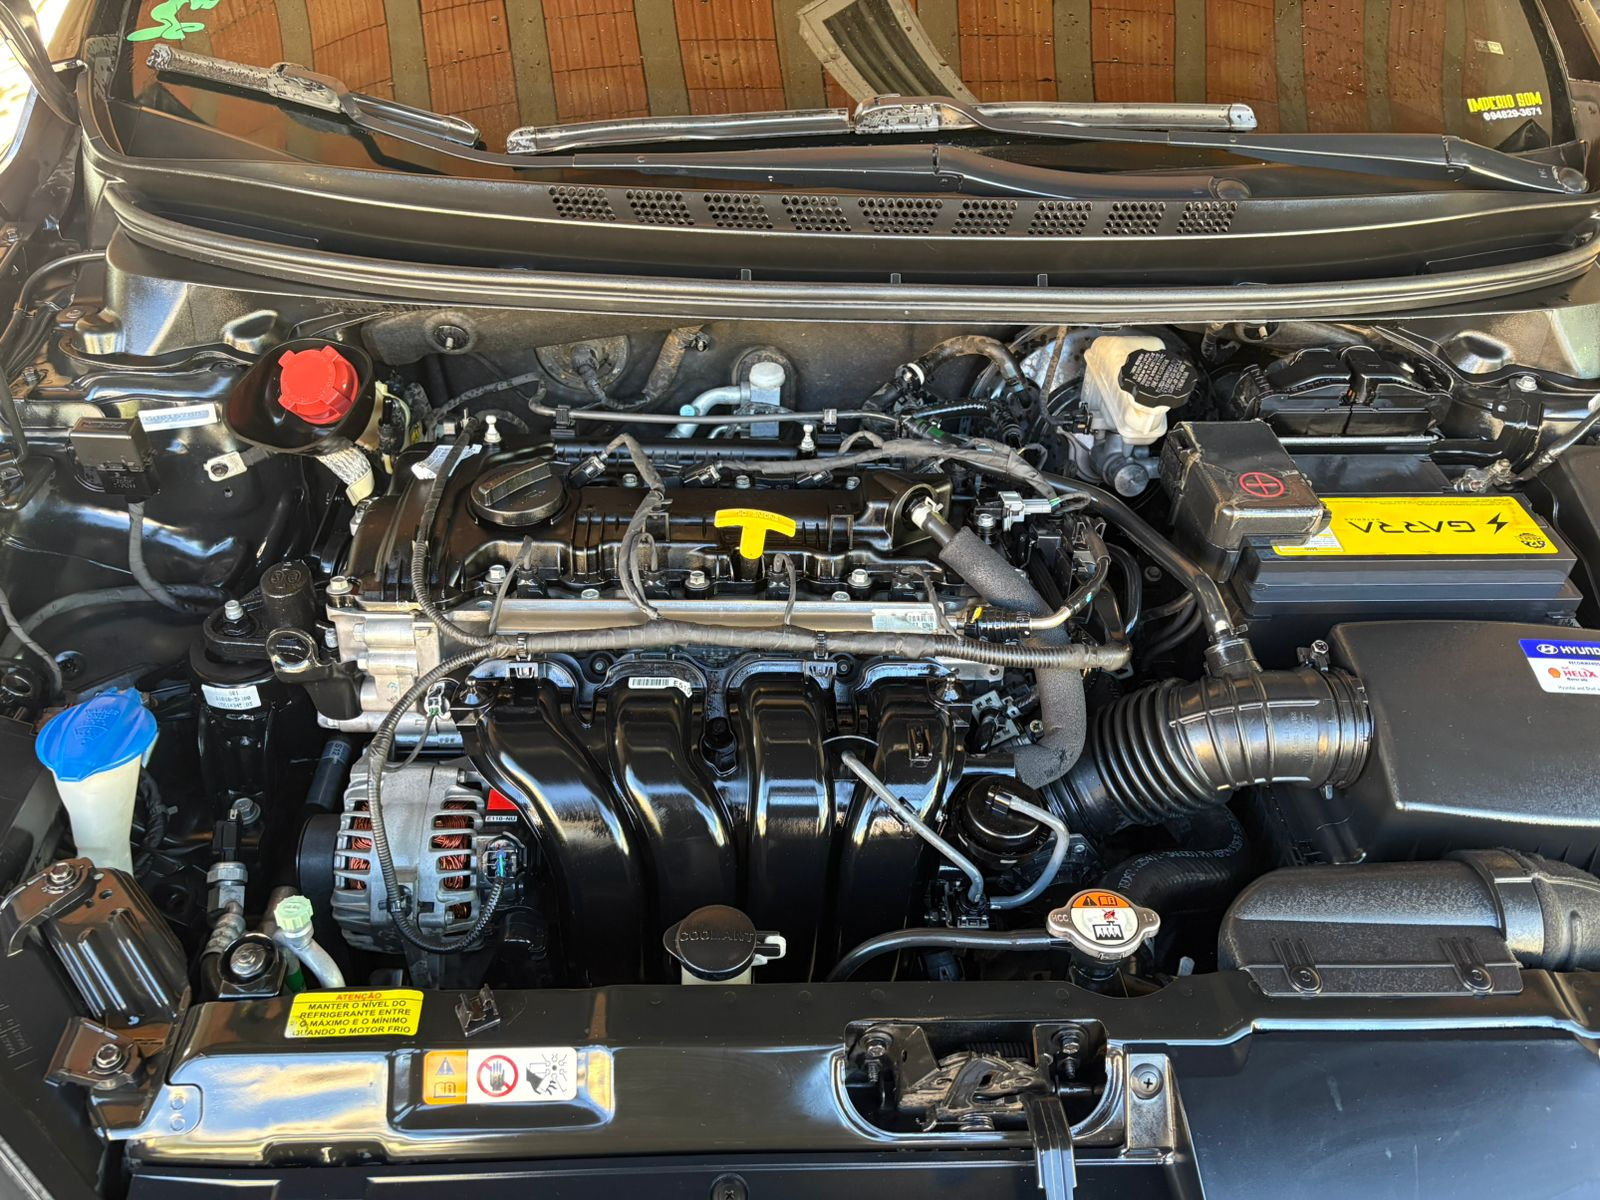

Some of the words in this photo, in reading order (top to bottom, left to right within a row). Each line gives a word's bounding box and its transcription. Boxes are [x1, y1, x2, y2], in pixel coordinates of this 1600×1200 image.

[1515, 91, 1543, 107] SOM
[1346, 521, 1476, 533] GARRA
[1562, 669, 1598, 679] HELIX
[679, 930, 754, 943] COOLANT
[336, 992, 382, 1001] ATENÇÃO
[362, 1001, 389, 1009] NÍVEL
[300, 1010, 377, 1018] REFRIGERANTE
[300, 1019, 307, 1027] O
[309, 1018, 350, 1027] MÁXIMO
[371, 1017, 408, 1025] MÍNIMO
[349, 1026, 385, 1034] MOTOR
[387, 1026, 411, 1034] FRIO
